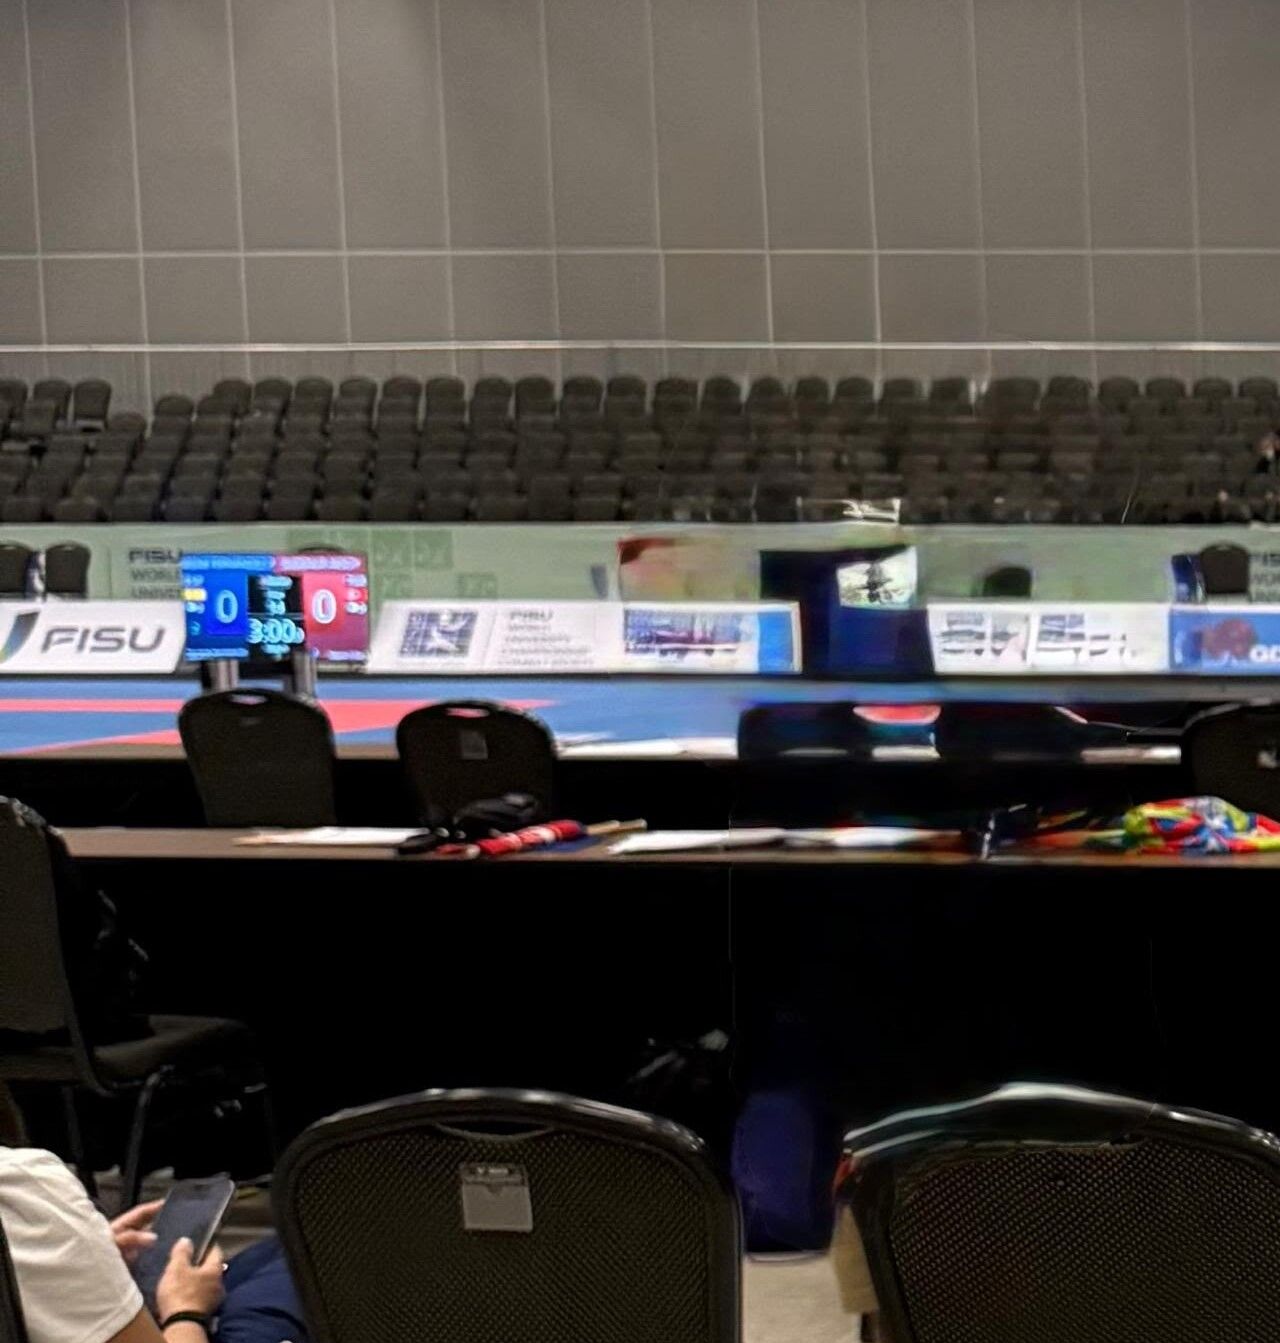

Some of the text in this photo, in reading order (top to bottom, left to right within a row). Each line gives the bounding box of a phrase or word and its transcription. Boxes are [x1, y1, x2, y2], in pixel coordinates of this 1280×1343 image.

[215, 589, 239, 624] 0
[311, 588, 337, 624] 0
[40, 627, 166, 653] FISU
